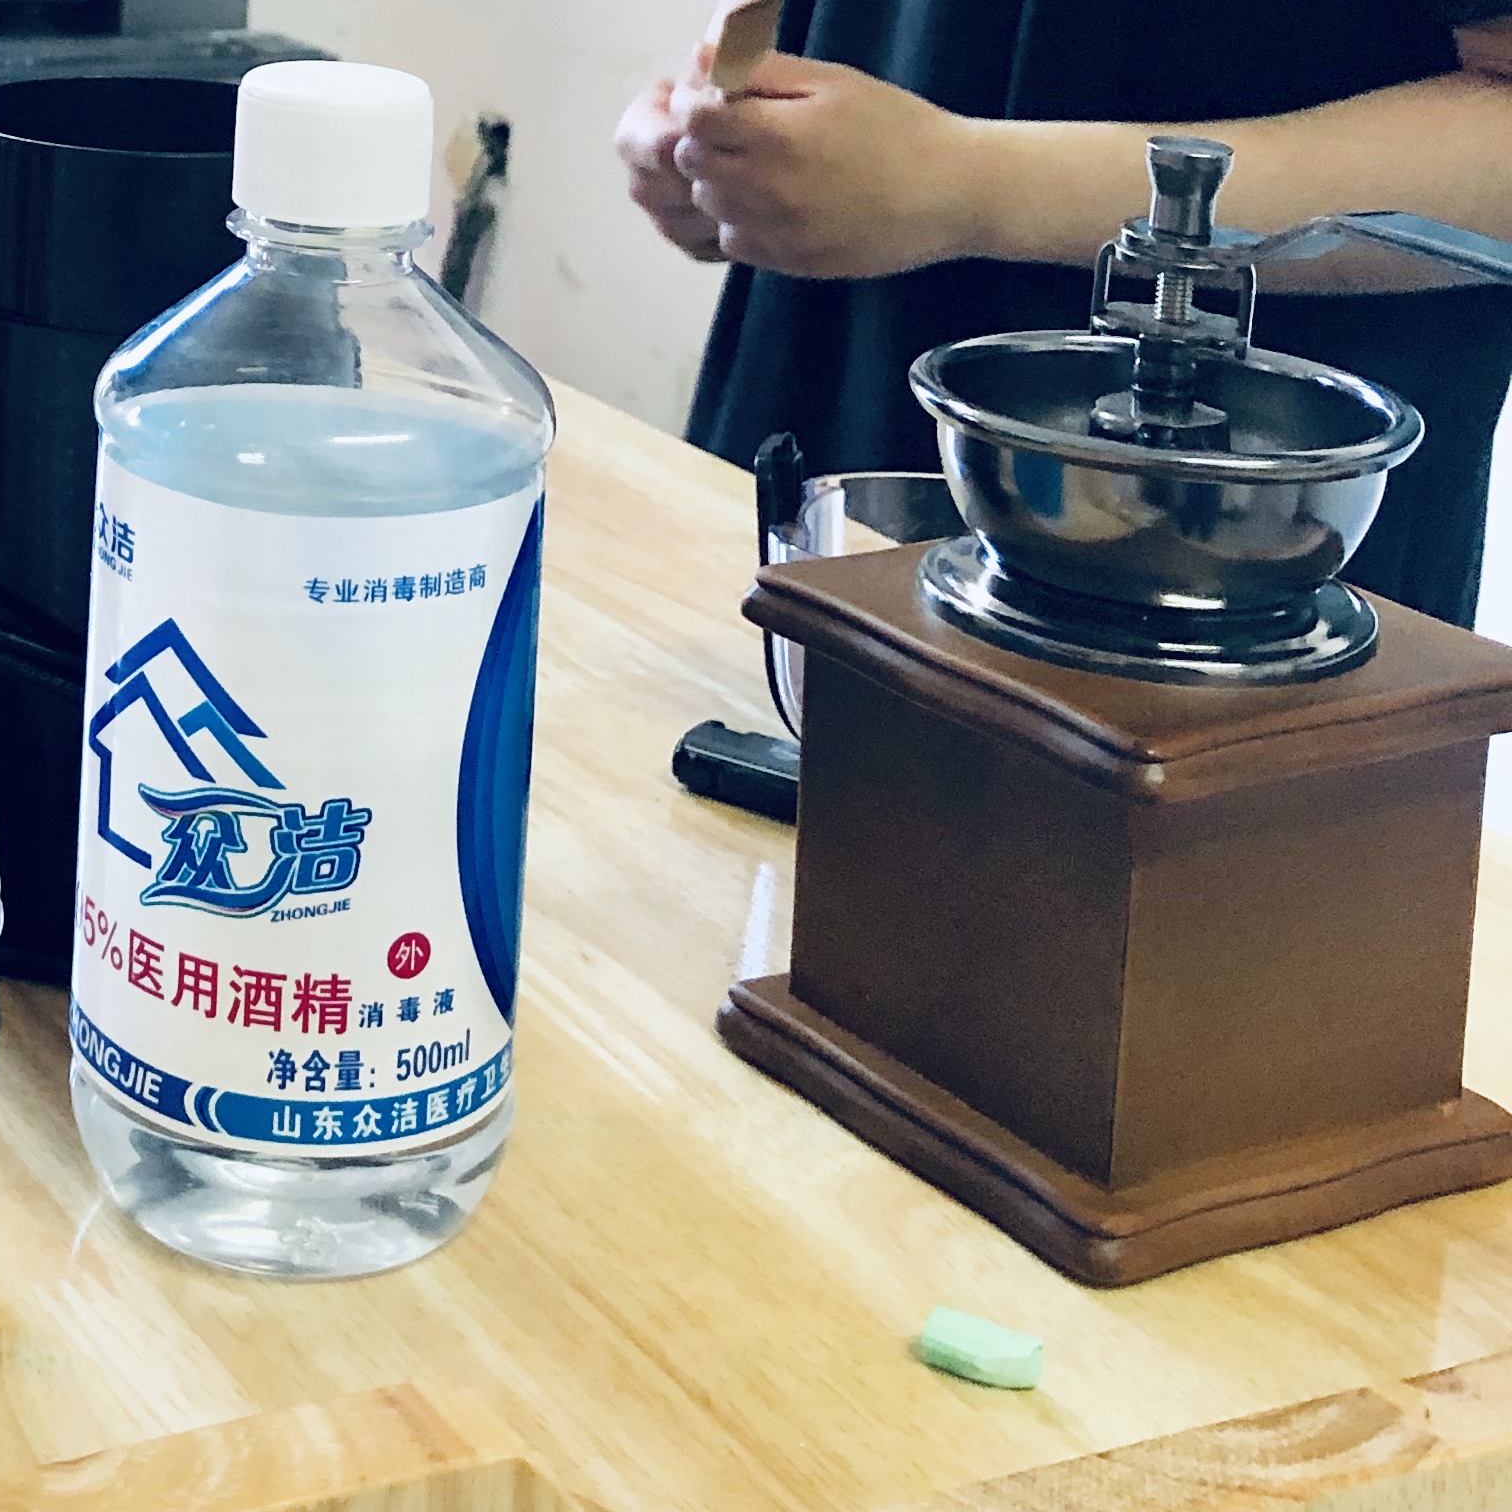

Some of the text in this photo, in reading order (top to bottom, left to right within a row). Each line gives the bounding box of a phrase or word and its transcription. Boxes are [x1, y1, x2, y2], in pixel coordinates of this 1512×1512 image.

[303, 563, 488, 604] 专业消毒制造商
[140, 784, 373, 919] 众洁
[270, 898, 352, 923] ZHONGJIE
[81, 894, 455, 1036] 5%医用酒精 消毒液
[394, 940, 423, 972] 外
[72, 1008, 163, 1105] ONGJIE
[396, 1028, 471, 1082] 500ml
